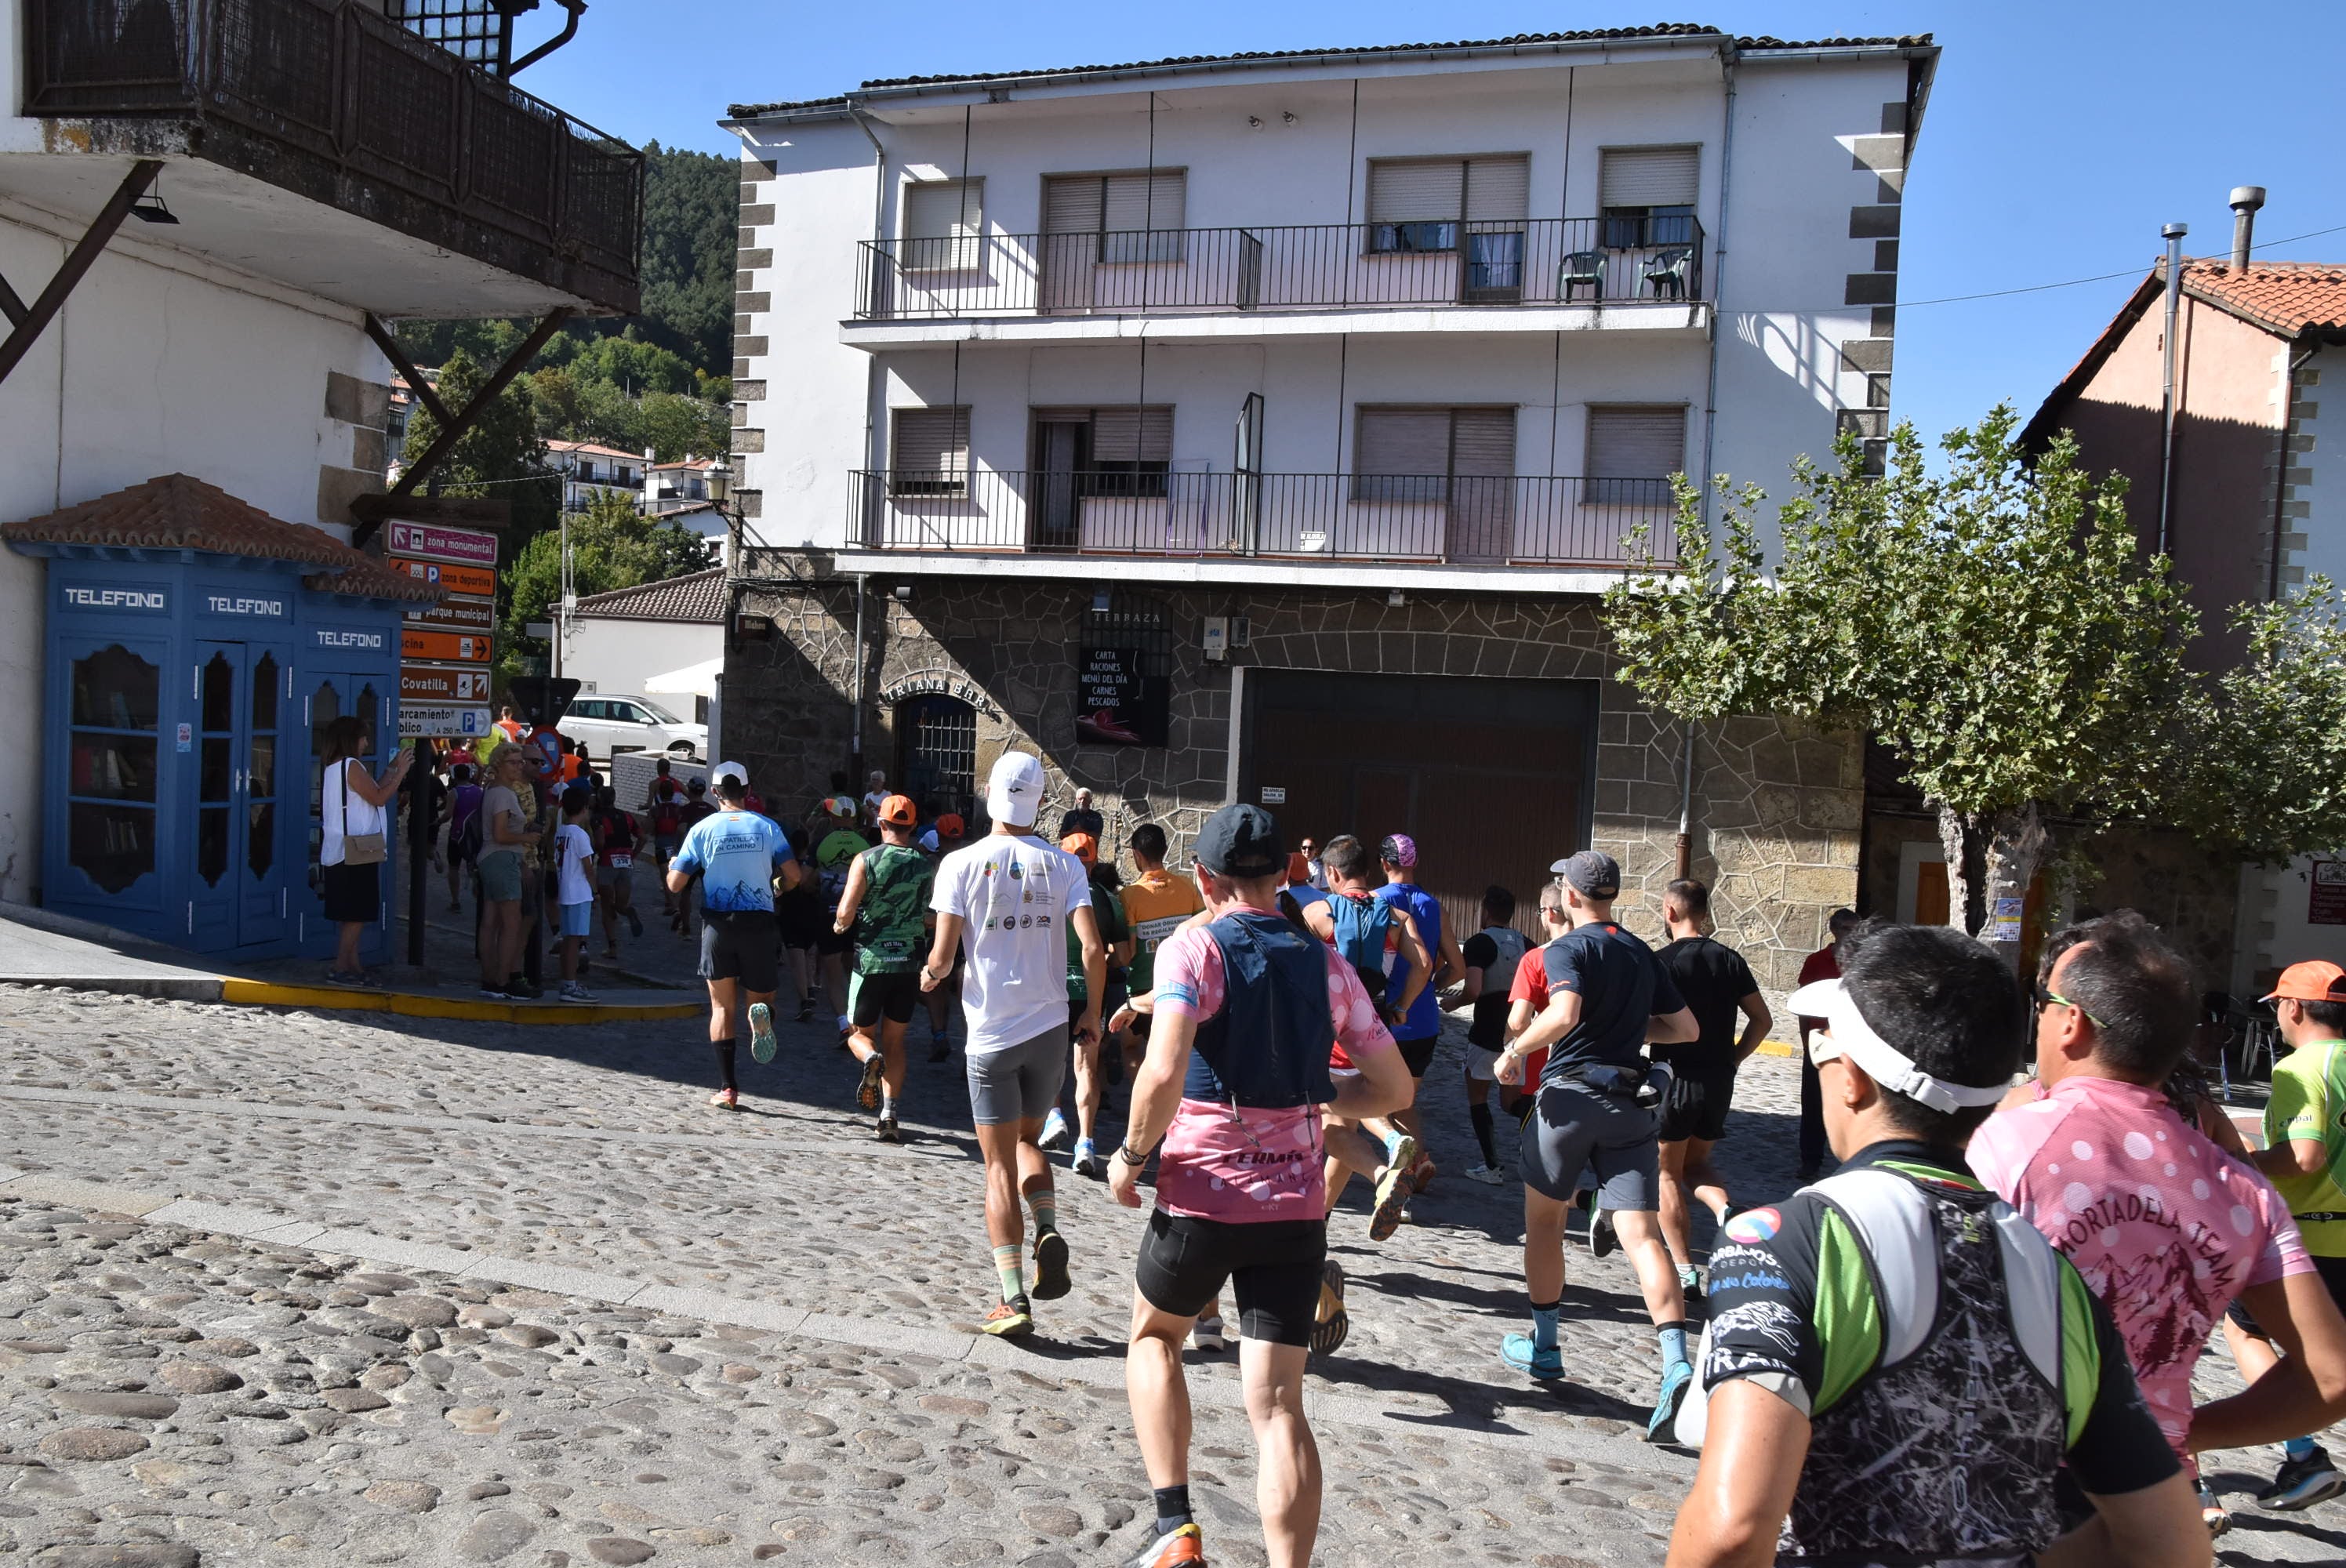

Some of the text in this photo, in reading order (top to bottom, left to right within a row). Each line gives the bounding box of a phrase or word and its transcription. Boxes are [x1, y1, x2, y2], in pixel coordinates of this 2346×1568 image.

[427, 537, 492, 554] zona monumental
[428, 566, 490, 587] P zona deportiva
[65, 588, 164, 608] TELEFONO
[208, 596, 281, 615] TELEFONO
[456, 608, 490, 622] municipal
[1094, 613, 1160, 622] TERRAZA
[316, 630, 382, 648] TELEFONO
[401, 637, 424, 649] scina
[1095, 651, 1116, 659] CARTA
[1090, 662, 1120, 672] RACIONES
[401, 677, 448, 691] Covatilla
[1081, 673, 1128, 684] MENÚ DEL DÍA
[1091, 686, 1117, 695] CARNES
[1088, 696, 1120, 706] PESCADOS
[399, 709, 450, 719] arcamiento
[399, 721, 422, 733] blico
[714, 836, 753, 844] ZAPATILLA
[1162, 918, 1186, 927] ORGAN
[2190, 1221, 2235, 1288] TEAM
